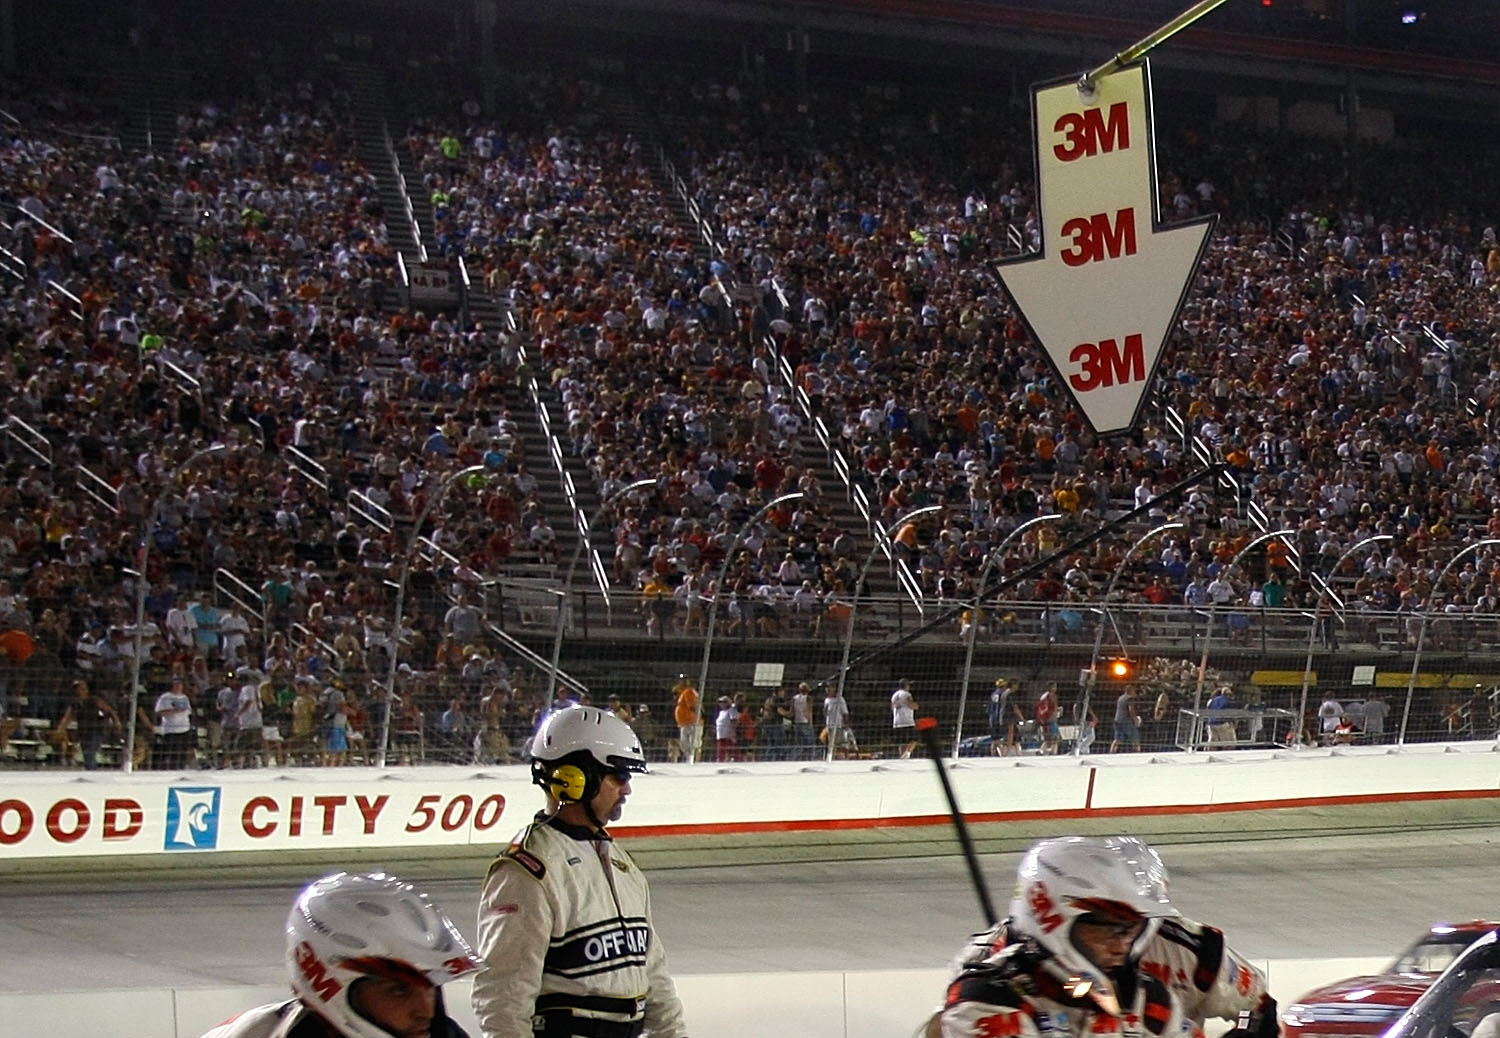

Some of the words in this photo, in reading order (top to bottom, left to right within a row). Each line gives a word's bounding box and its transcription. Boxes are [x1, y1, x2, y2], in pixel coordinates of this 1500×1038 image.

[1053, 103, 1129, 161] 3M
[1060, 208, 1136, 267] 3M
[1068, 334, 1145, 392] 3M
[241, 796, 390, 838] CITY
[405, 794, 506, 834] 500
[295, 940, 344, 1003] 3M
